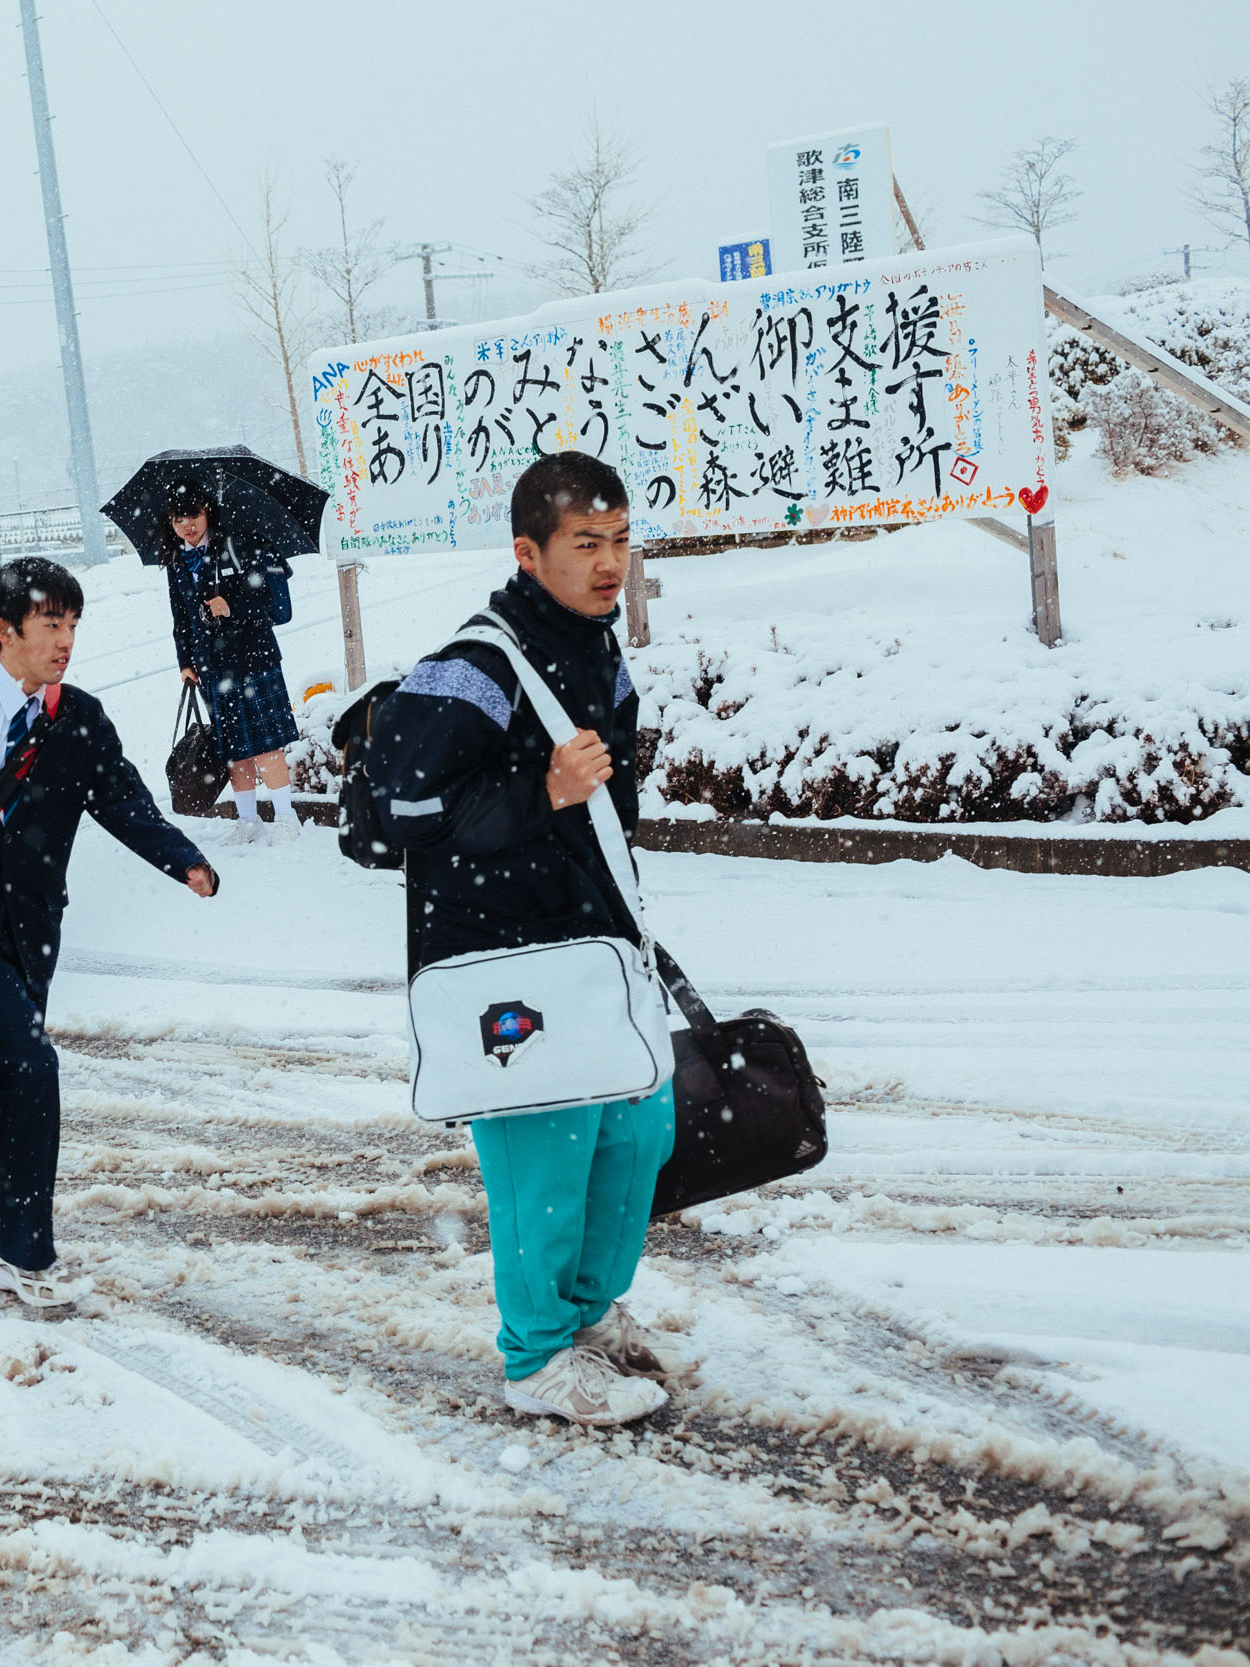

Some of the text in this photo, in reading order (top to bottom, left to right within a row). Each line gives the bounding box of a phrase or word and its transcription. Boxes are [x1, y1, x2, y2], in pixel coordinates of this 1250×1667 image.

[837, 178, 865, 262] 南三陸
[312, 362, 350, 402] ANA
[645, 427, 953, 513] の森避難所
